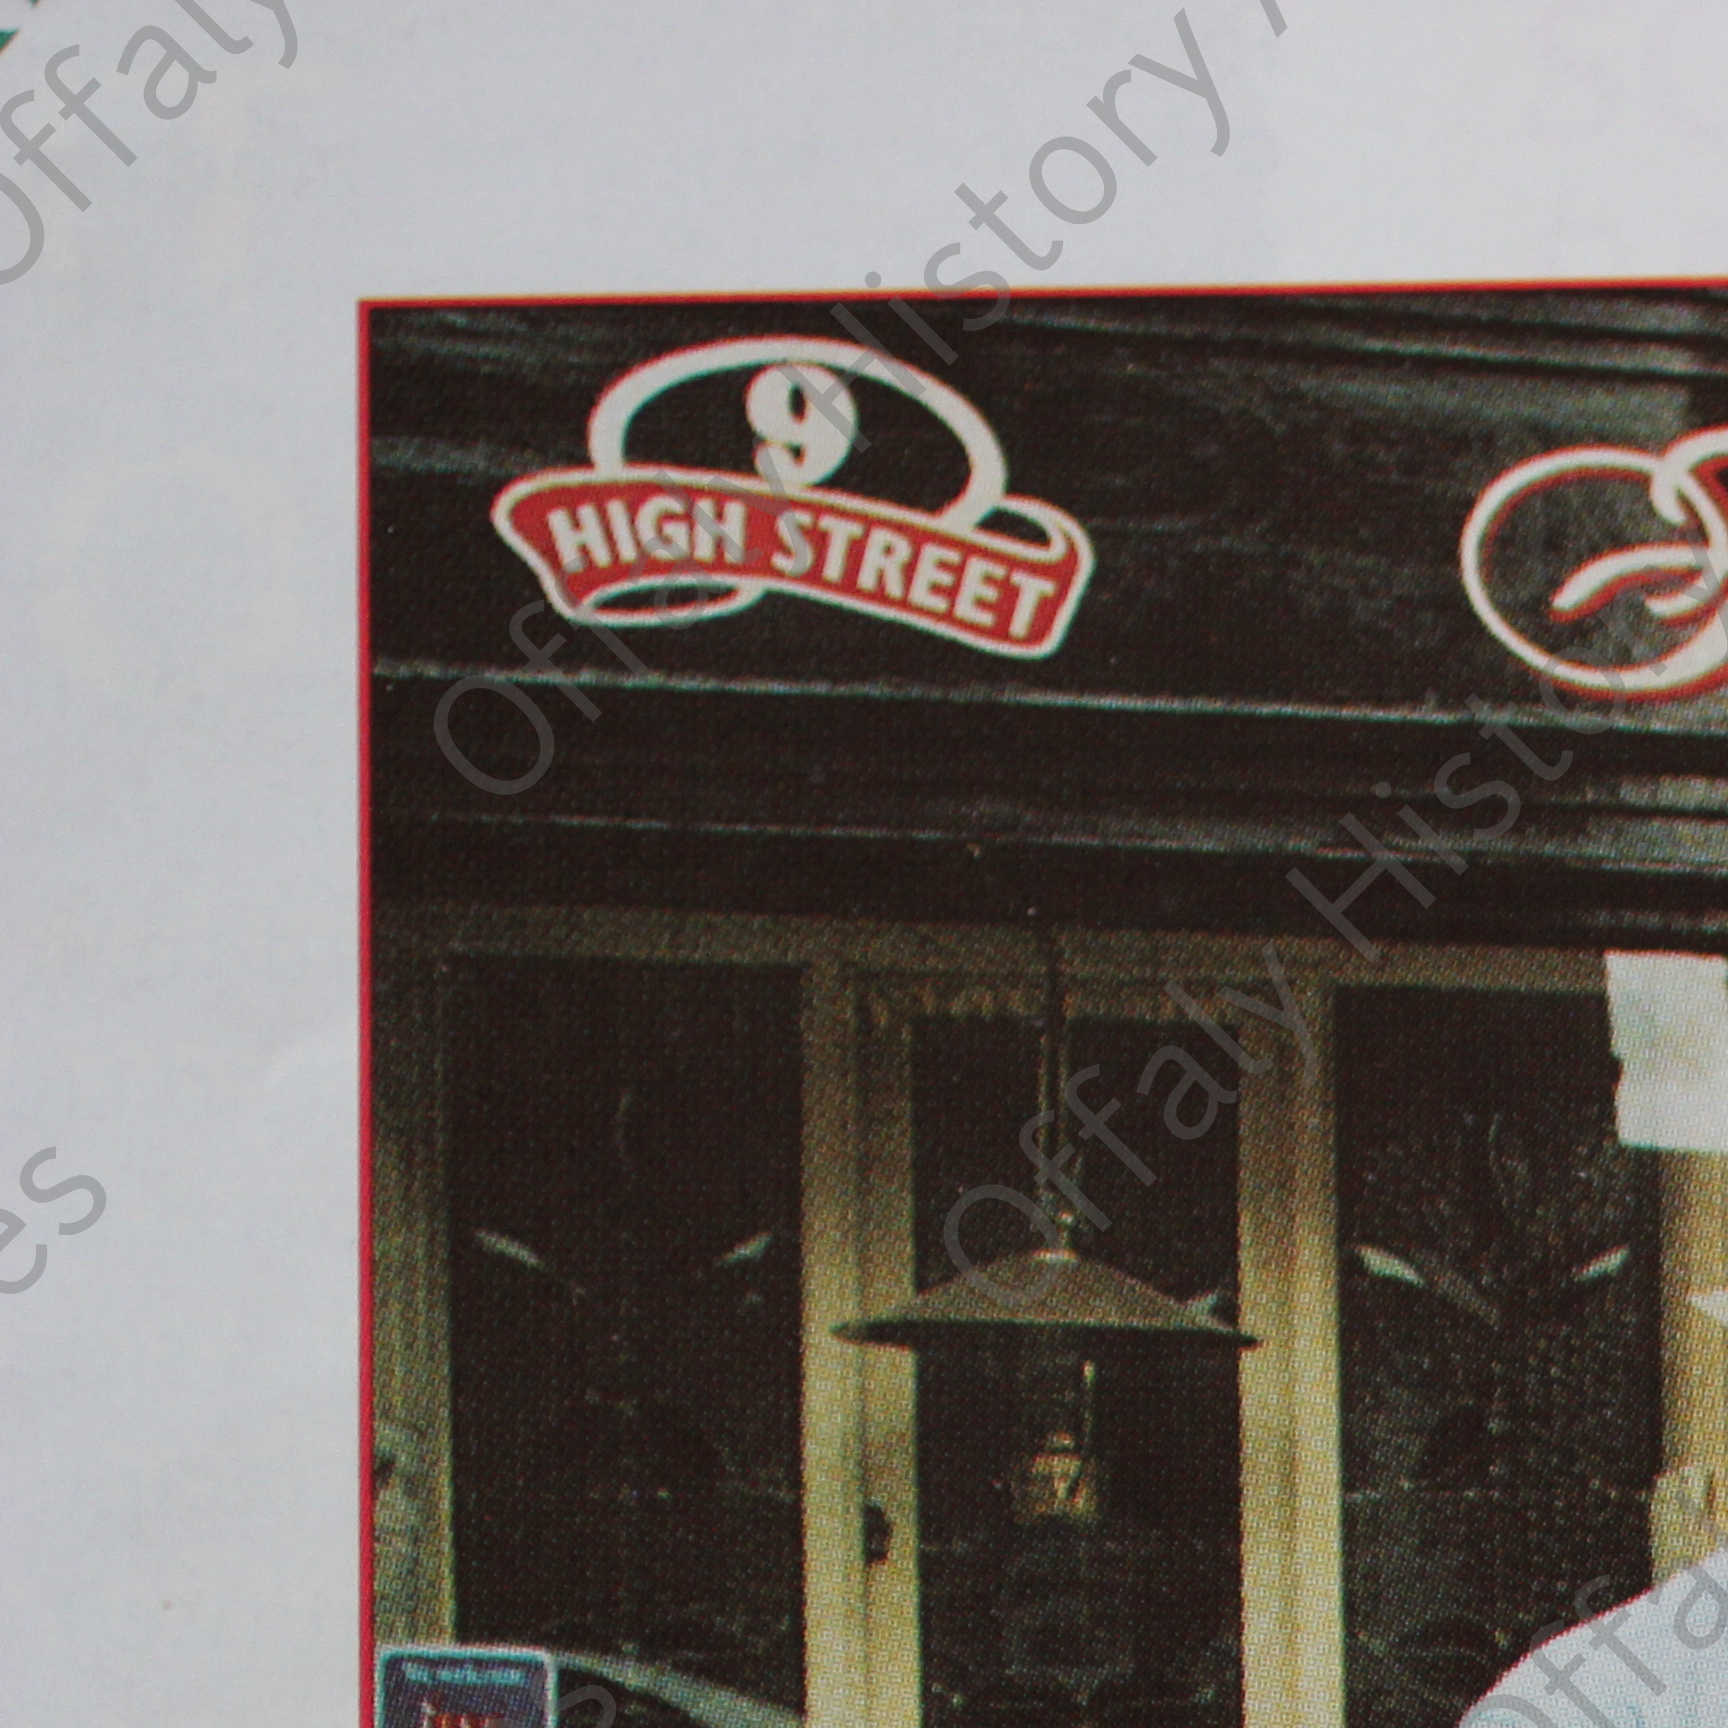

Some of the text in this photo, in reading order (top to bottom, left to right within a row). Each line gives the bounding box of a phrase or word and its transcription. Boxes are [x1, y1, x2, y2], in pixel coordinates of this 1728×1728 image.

[746, 363, 859, 488] 9
[548, 495, 1057, 643] HIGH STREET
